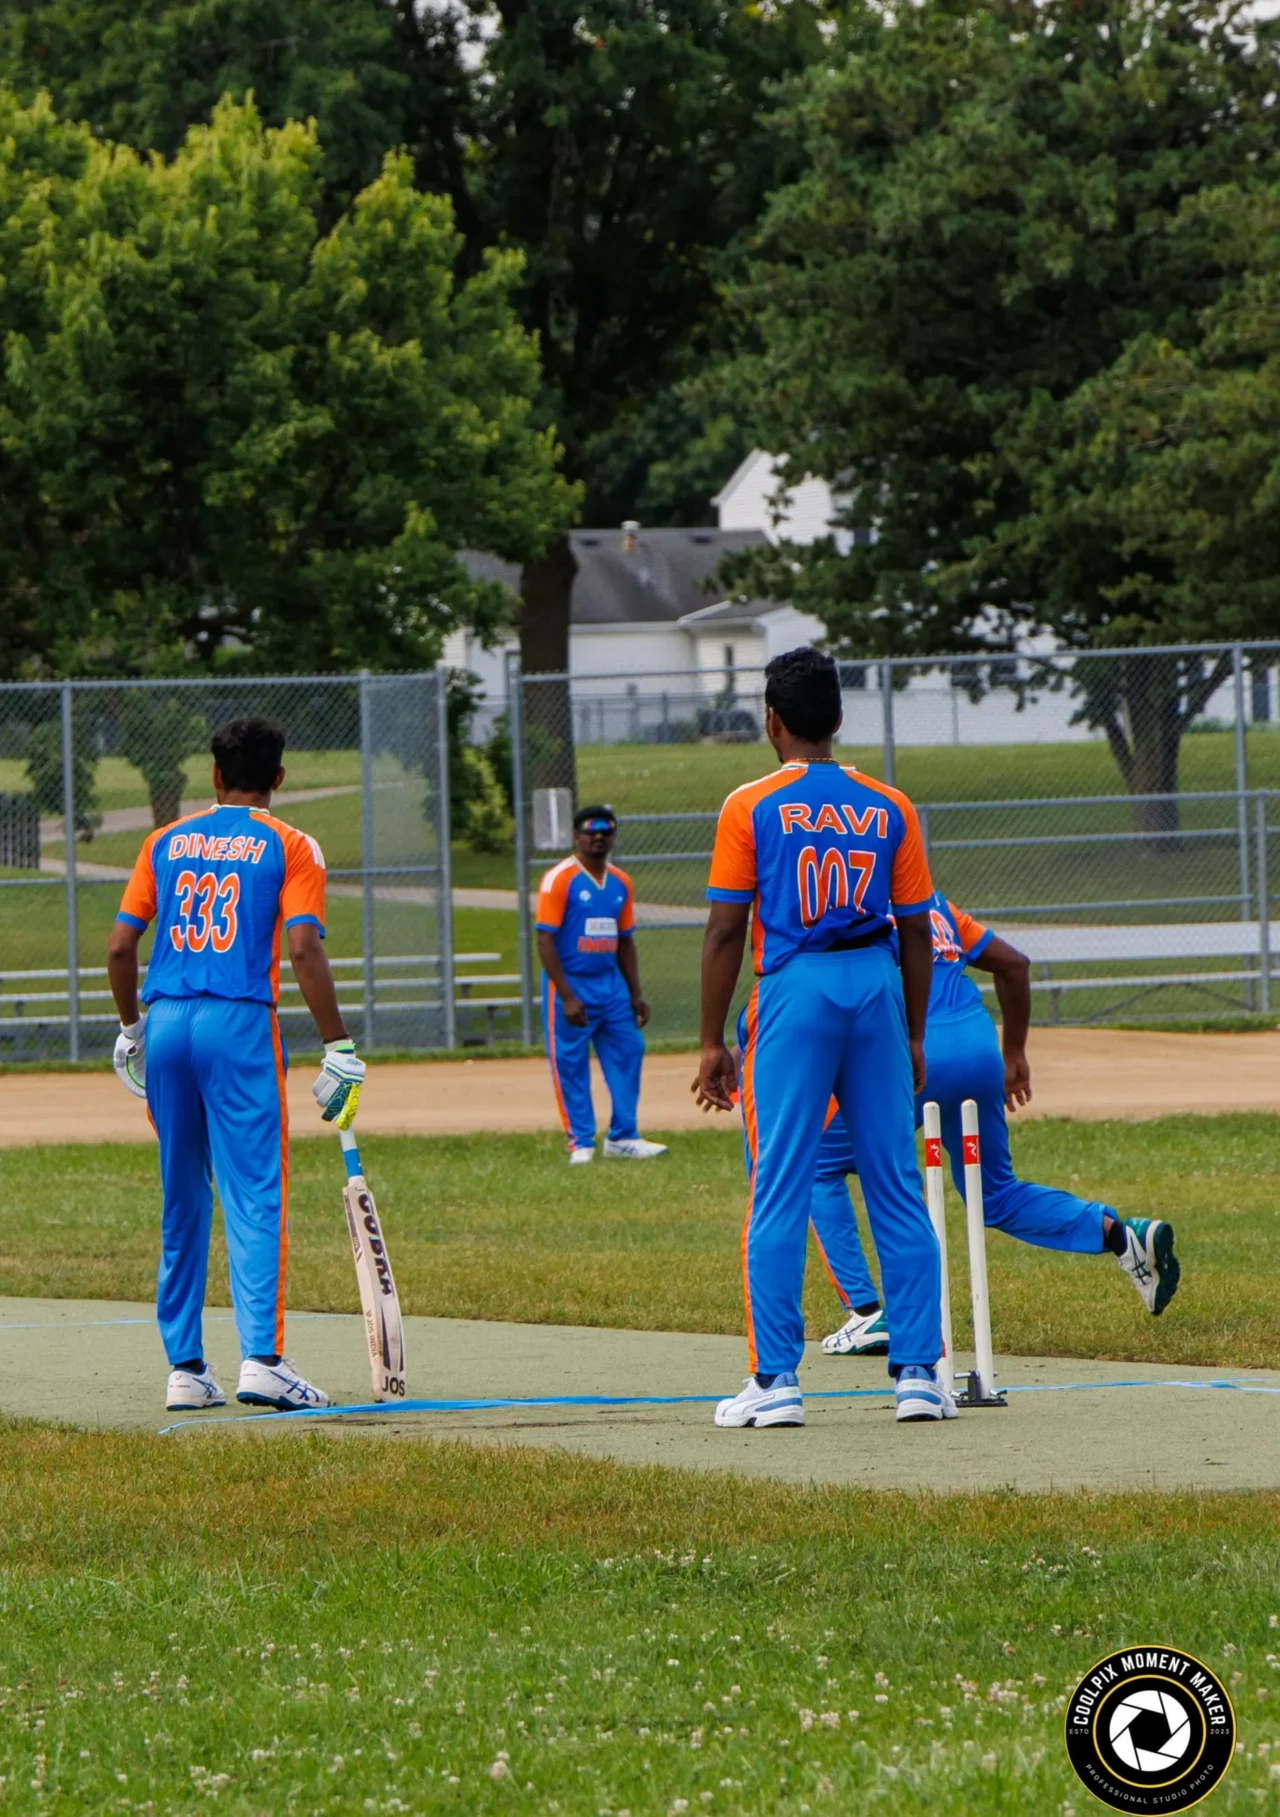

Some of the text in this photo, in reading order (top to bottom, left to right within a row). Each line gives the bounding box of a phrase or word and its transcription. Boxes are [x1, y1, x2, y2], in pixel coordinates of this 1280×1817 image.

[778, 803, 889, 839] RAVI
[168, 832, 267, 864] DINESH
[797, 845, 877, 929] 007
[169, 870, 241, 953] 333
[577, 935, 619, 953] INDI
[382, 1375, 406, 1397] JOS
